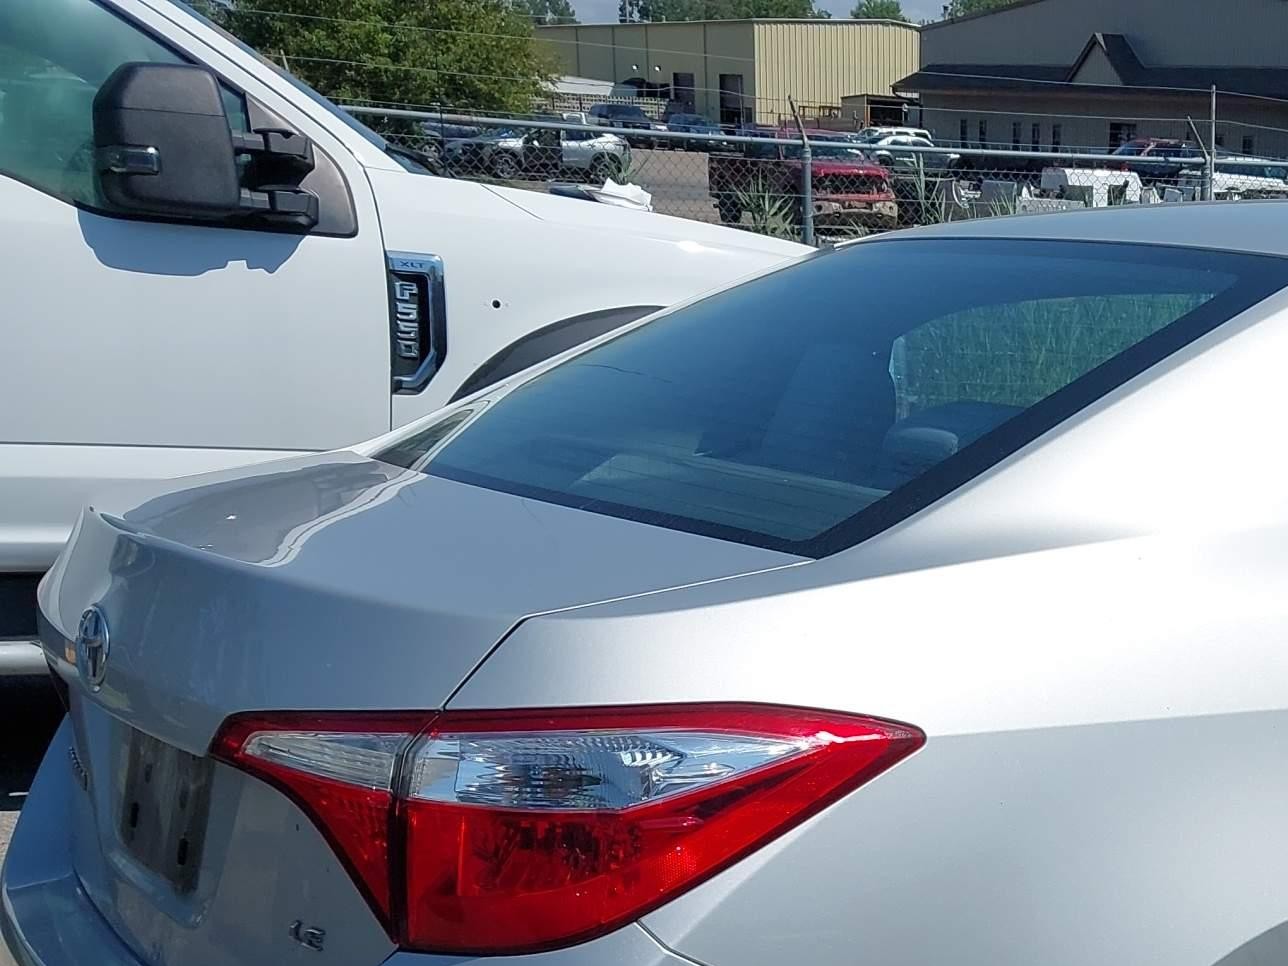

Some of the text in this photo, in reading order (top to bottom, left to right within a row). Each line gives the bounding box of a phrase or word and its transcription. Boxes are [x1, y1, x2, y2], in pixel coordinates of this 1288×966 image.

[400, 261, 424, 270] XLT
[394, 280, 419, 359] F550
[288, 920, 326, 952] LE
